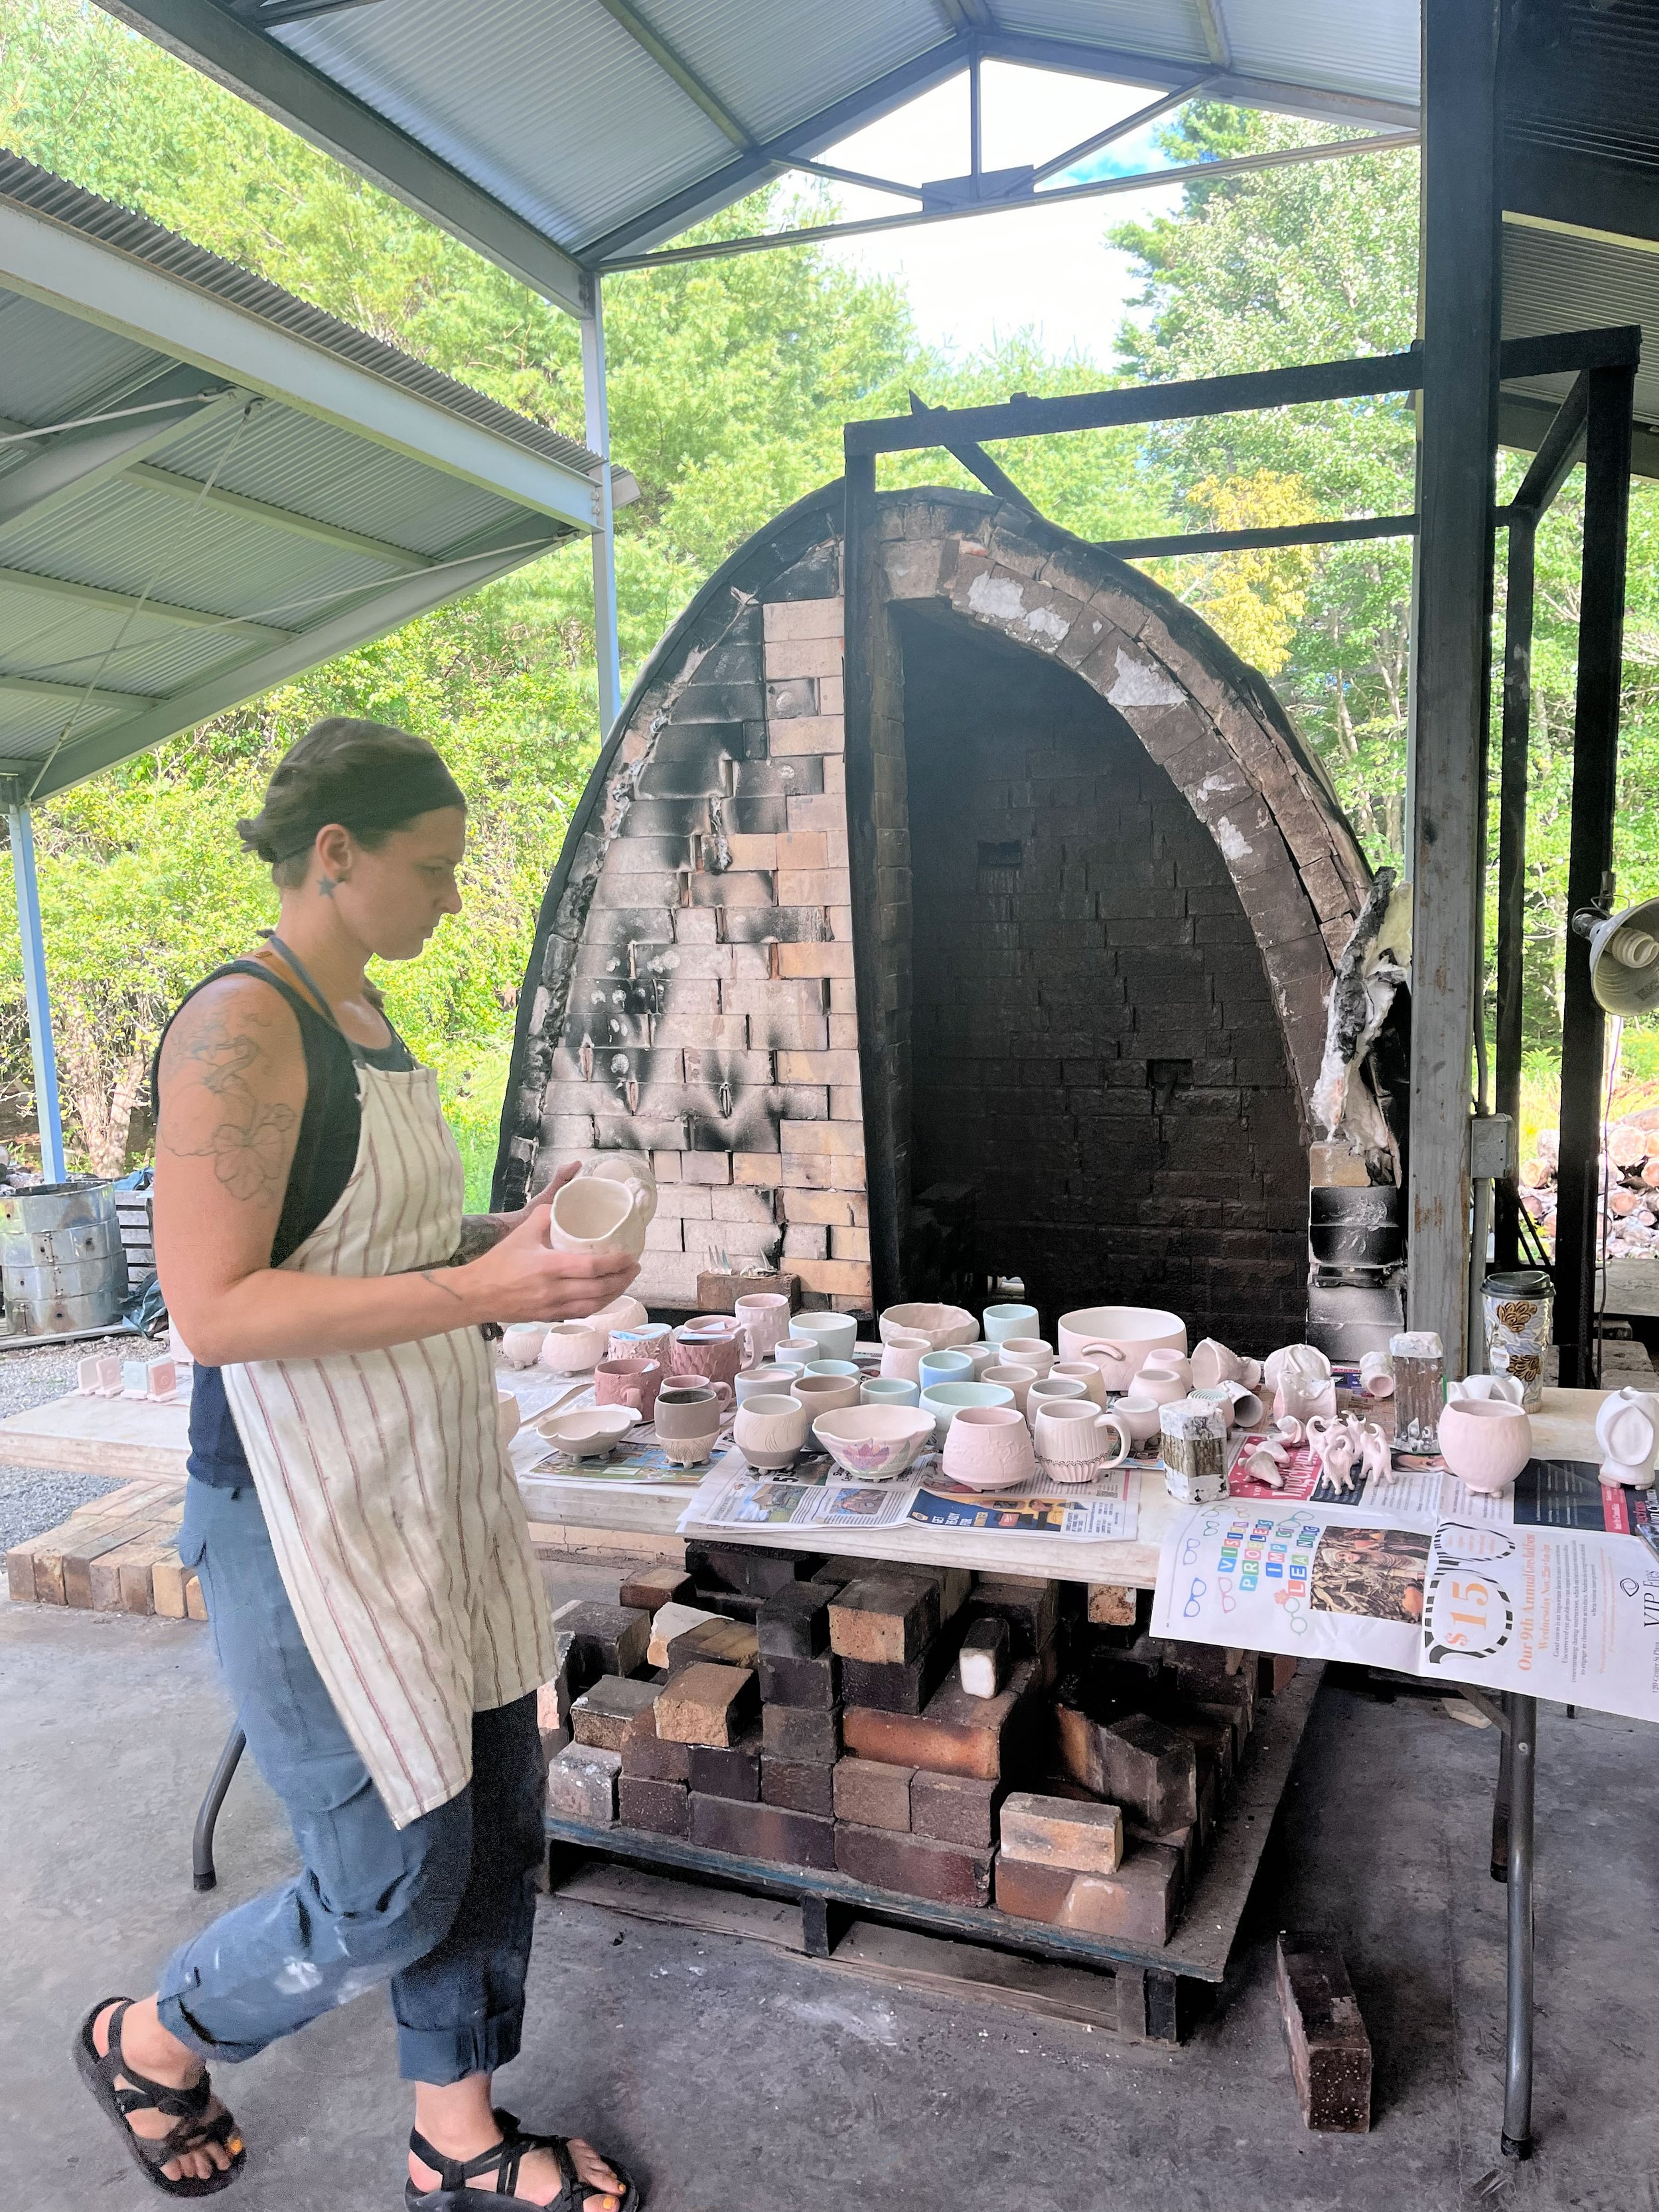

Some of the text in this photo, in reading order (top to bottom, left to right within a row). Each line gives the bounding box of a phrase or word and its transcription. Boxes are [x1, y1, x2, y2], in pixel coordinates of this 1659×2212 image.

[1218, 1522, 1248, 1572] VISION
[1266, 1528, 1294, 1577] IMPCT
[1289, 1526, 1319, 1596] LEANIG
[1444, 1582, 1489, 1646] $15
[1522, 1576, 1535, 1613] Annual
[1644, 1593, 1659, 1627] VIP
[1520, 1617, 1534, 1641] 9th
[1538, 1597, 1551, 1650] Wednesday
[1518, 1643, 1533, 1671] Our
